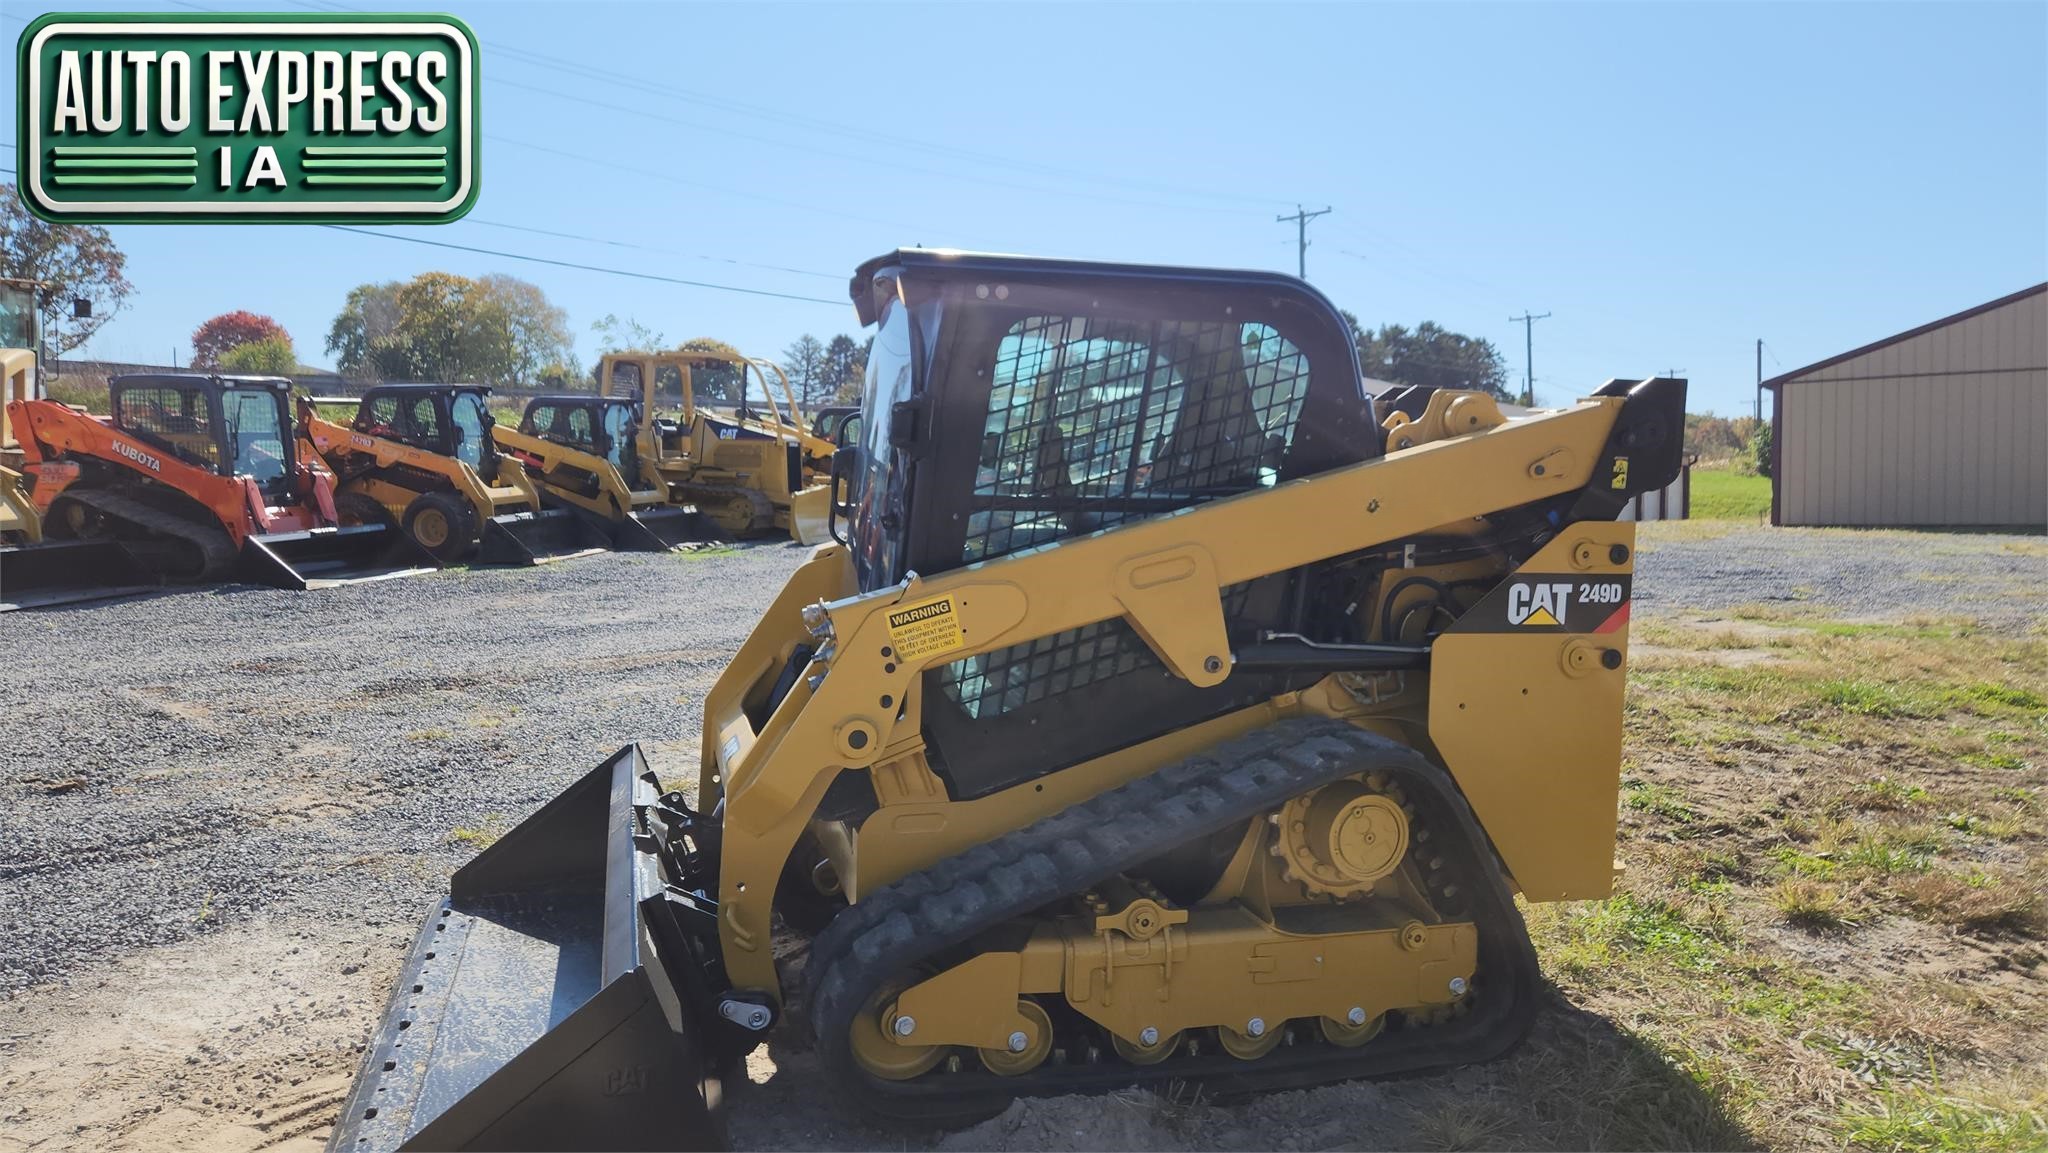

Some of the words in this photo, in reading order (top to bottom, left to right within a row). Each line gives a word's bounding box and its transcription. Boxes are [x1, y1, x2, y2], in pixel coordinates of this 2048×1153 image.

[720, 428, 738, 440] CAT
[112, 440, 160, 472] KUBOTA
[891, 602, 949, 626] WARNING
[1507, 583, 1573, 625] CAT
[1578, 583, 1622, 603] 249D
[894, 625, 922, 638] UNLAWFUL
[923, 622, 930, 630] TO
[931, 616, 953, 628] OPERATE
[894, 637, 908, 646] THIS
[908, 628, 937, 642] EQUIPMENT
[938, 623, 957, 633] WITHIN
[906, 641, 919, 650] FEET
[920, 638, 927, 646] OF
[928, 631, 956, 644] OVERHEAD
[917, 644, 941, 655] VOLTAGE
[941, 639, 956, 648] LINES
[602, 1064, 651, 1096] CAT
